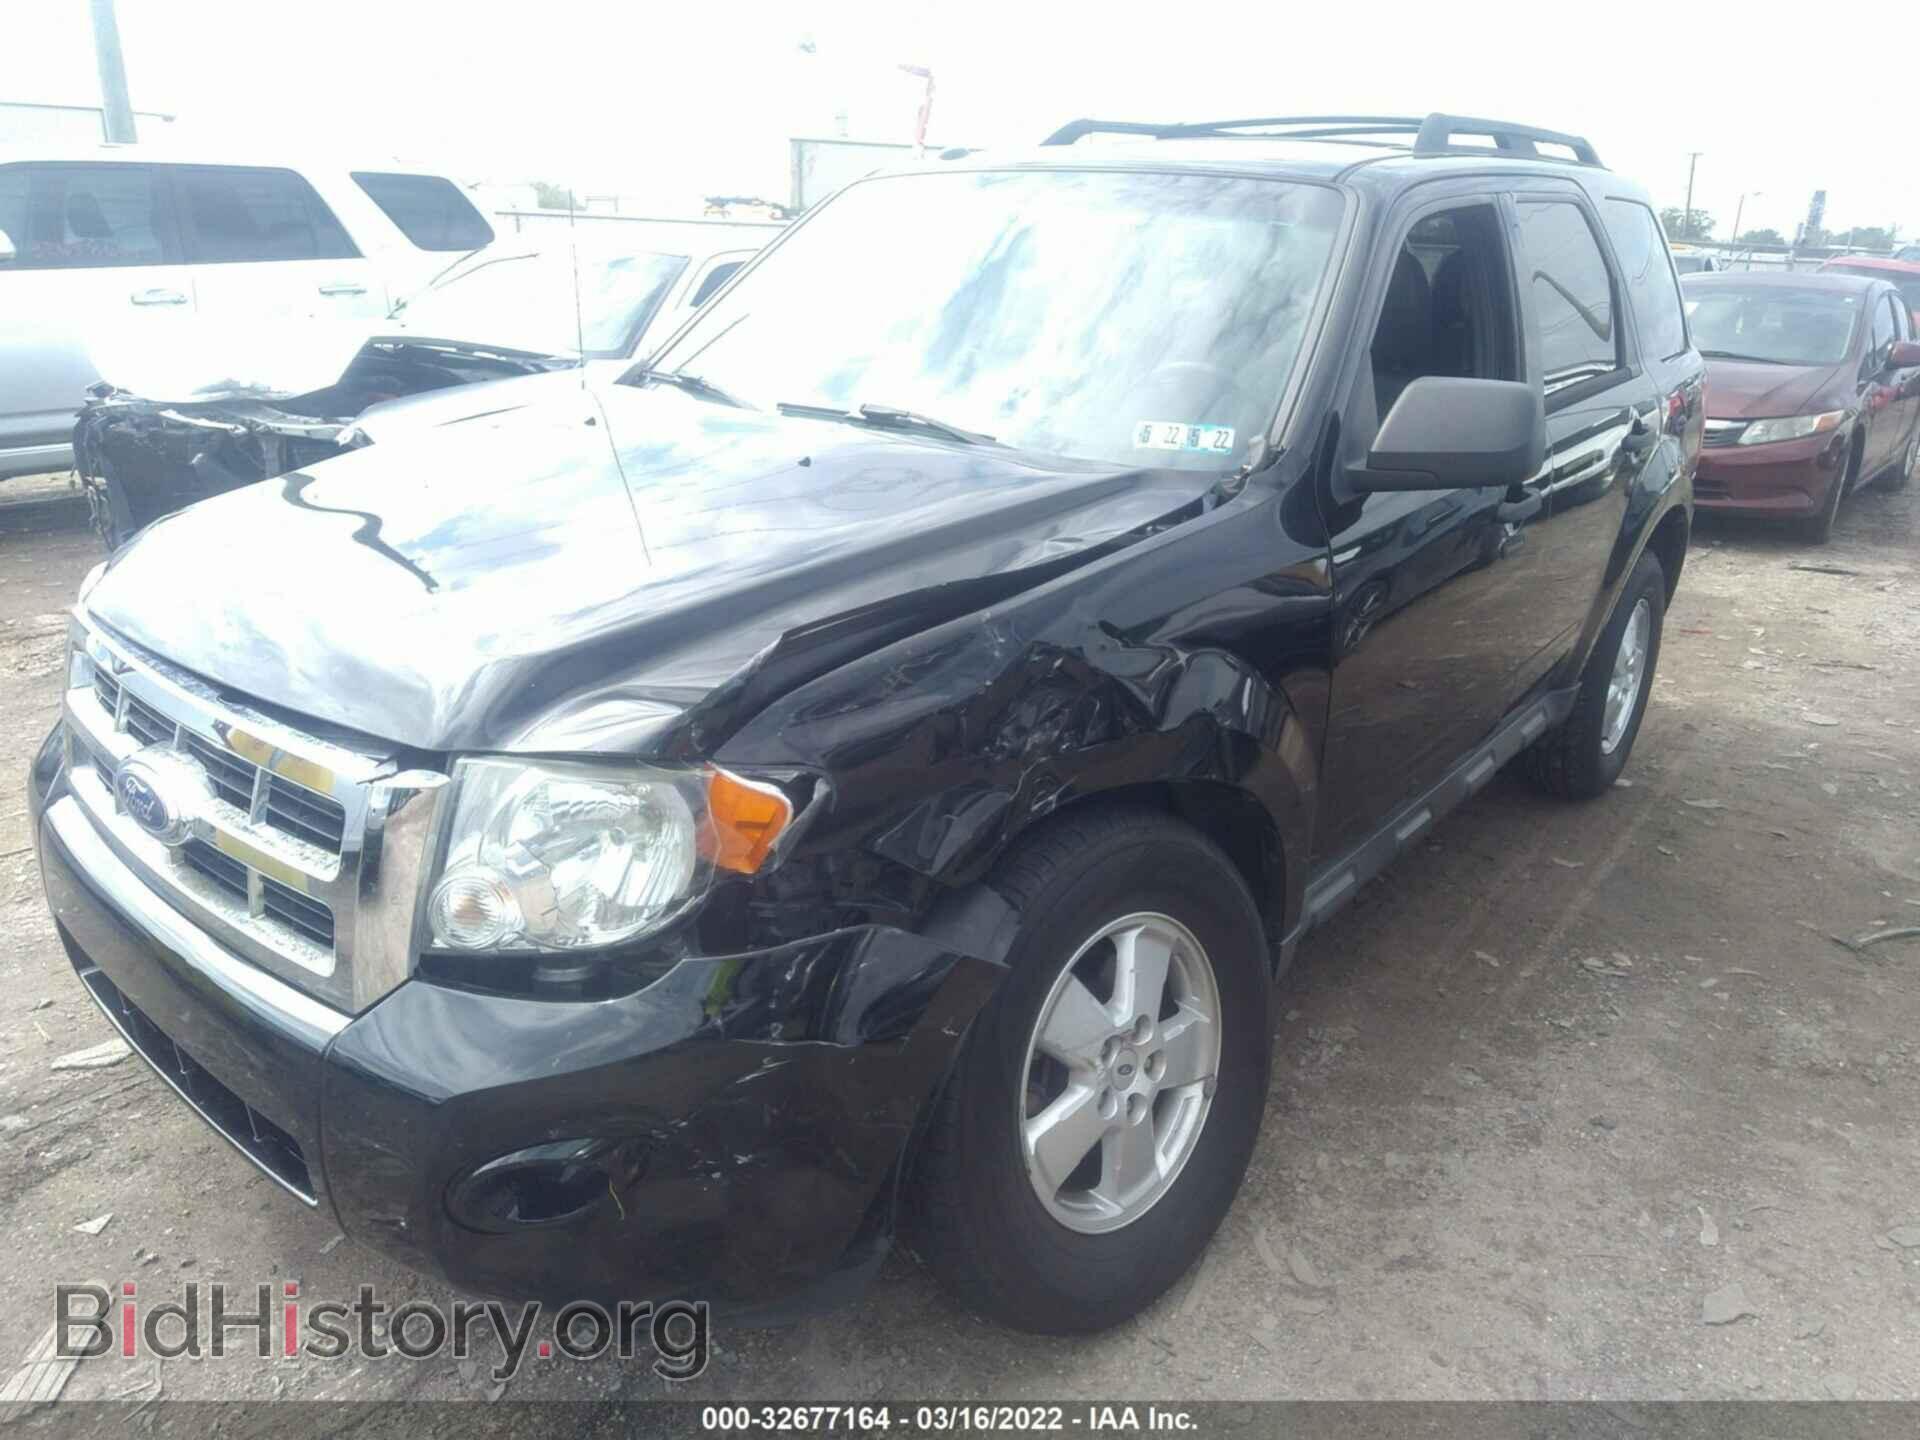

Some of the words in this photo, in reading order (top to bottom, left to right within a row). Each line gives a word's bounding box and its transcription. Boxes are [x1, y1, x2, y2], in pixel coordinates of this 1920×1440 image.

[1163, 426, 1180, 444] 22
[1213, 430, 1230, 449] 22
[125, 776, 156, 822] Ford
